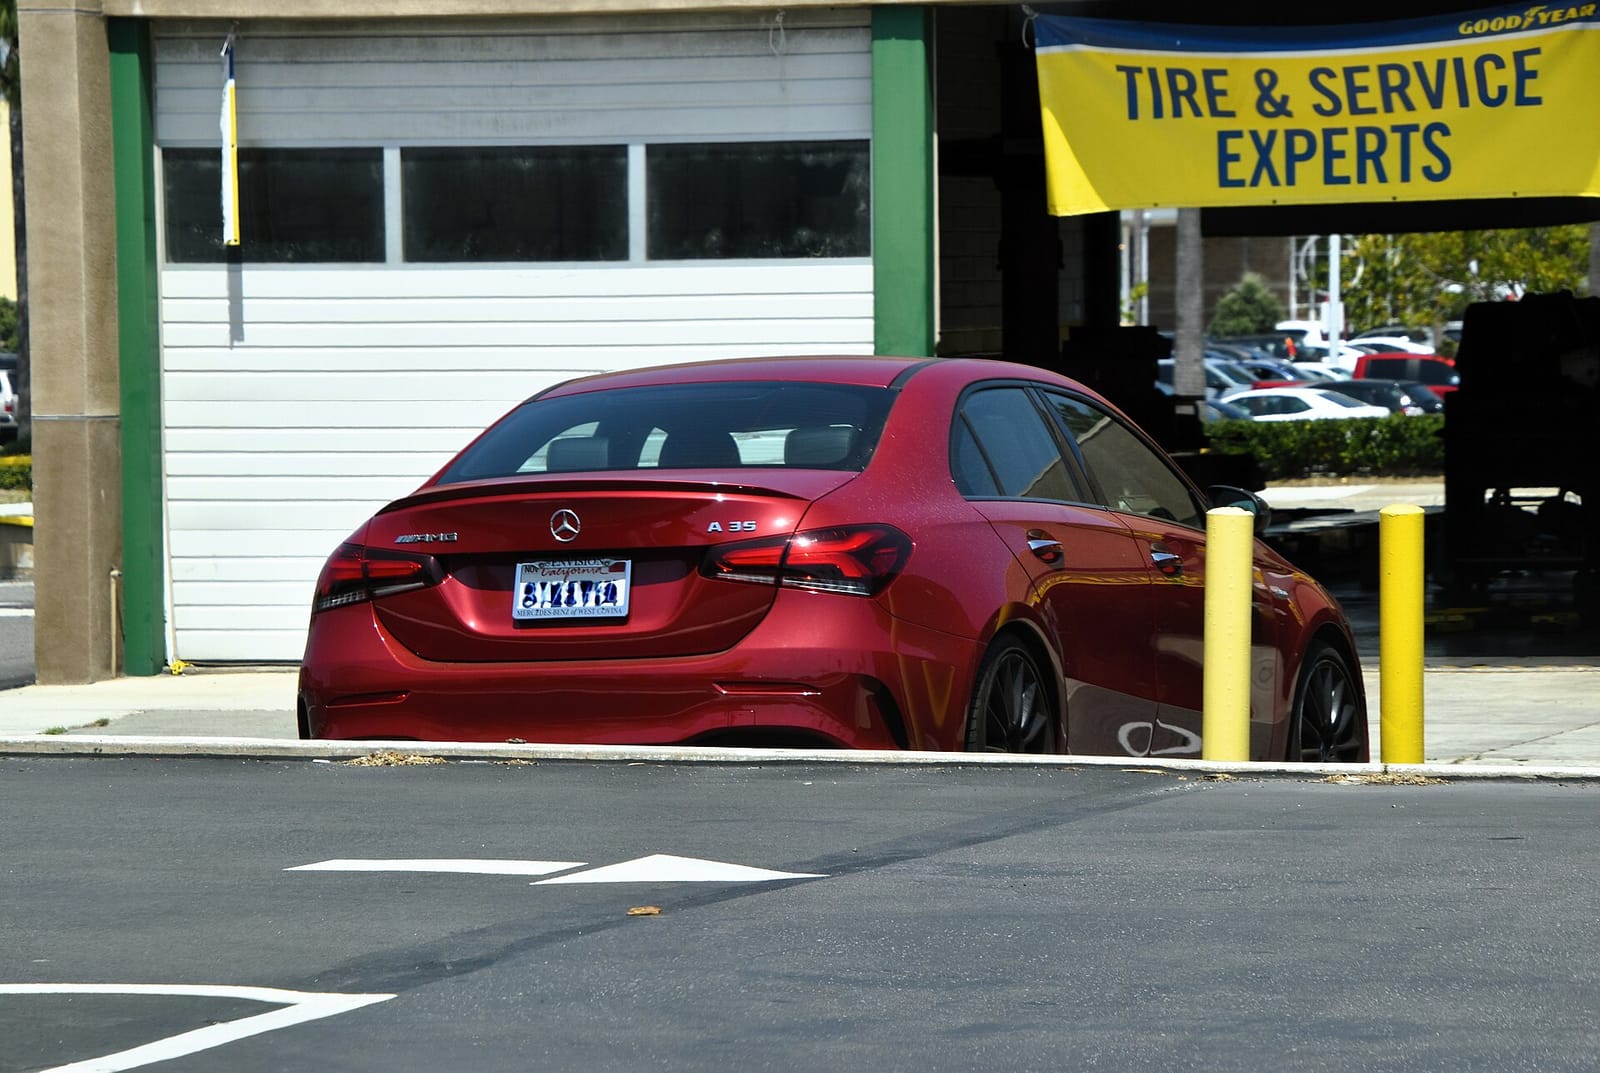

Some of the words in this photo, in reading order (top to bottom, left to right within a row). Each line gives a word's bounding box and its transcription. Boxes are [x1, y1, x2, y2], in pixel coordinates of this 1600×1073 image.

[1458, 4, 1597, 35] GOODYEAR
[1115, 64, 1237, 120] TIRE
[1254, 68, 1293, 118] &
[1308, 47, 1543, 116] SERVICE
[1217, 122, 1452, 188] EXPERTS
[707, 521, 723, 533] A
[728, 520, 757, 532] 35
[541, 567, 608, 582] California
[578, 607, 595, 615] WEST
